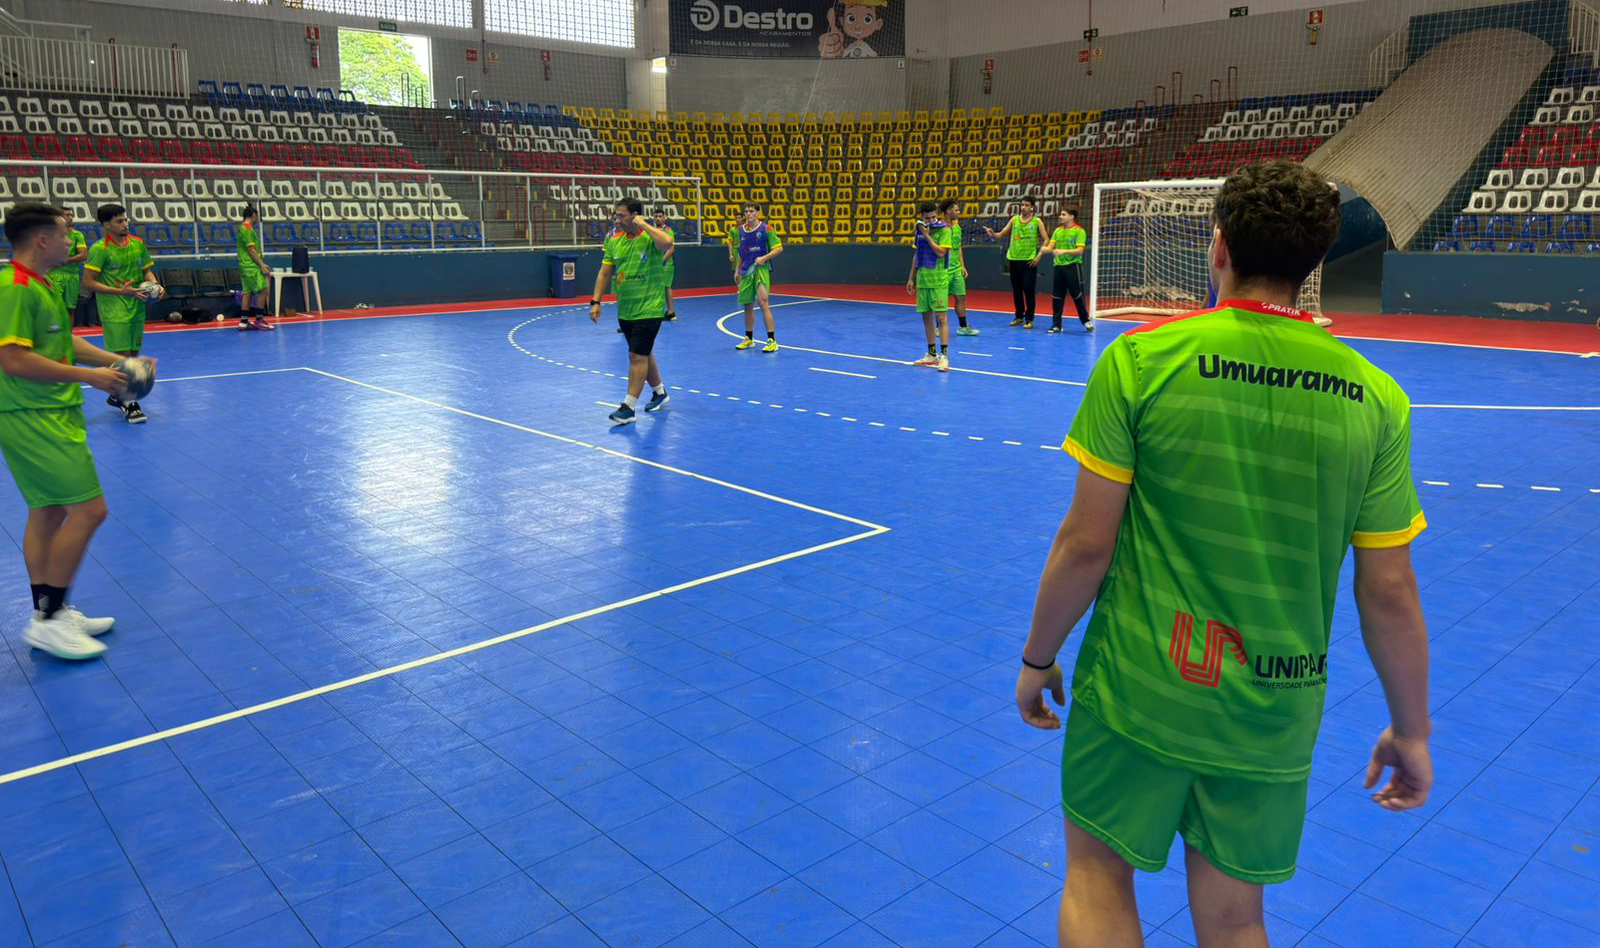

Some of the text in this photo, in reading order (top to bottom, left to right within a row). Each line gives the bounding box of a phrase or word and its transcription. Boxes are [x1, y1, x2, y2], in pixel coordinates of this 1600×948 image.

[724, 5, 814, 30] Destro
[1267, 303, 1301, 317] PRATIK
[1198, 354, 1364, 403] Umuarama
[1252, 679, 1302, 690] UNIVERSIDADE
